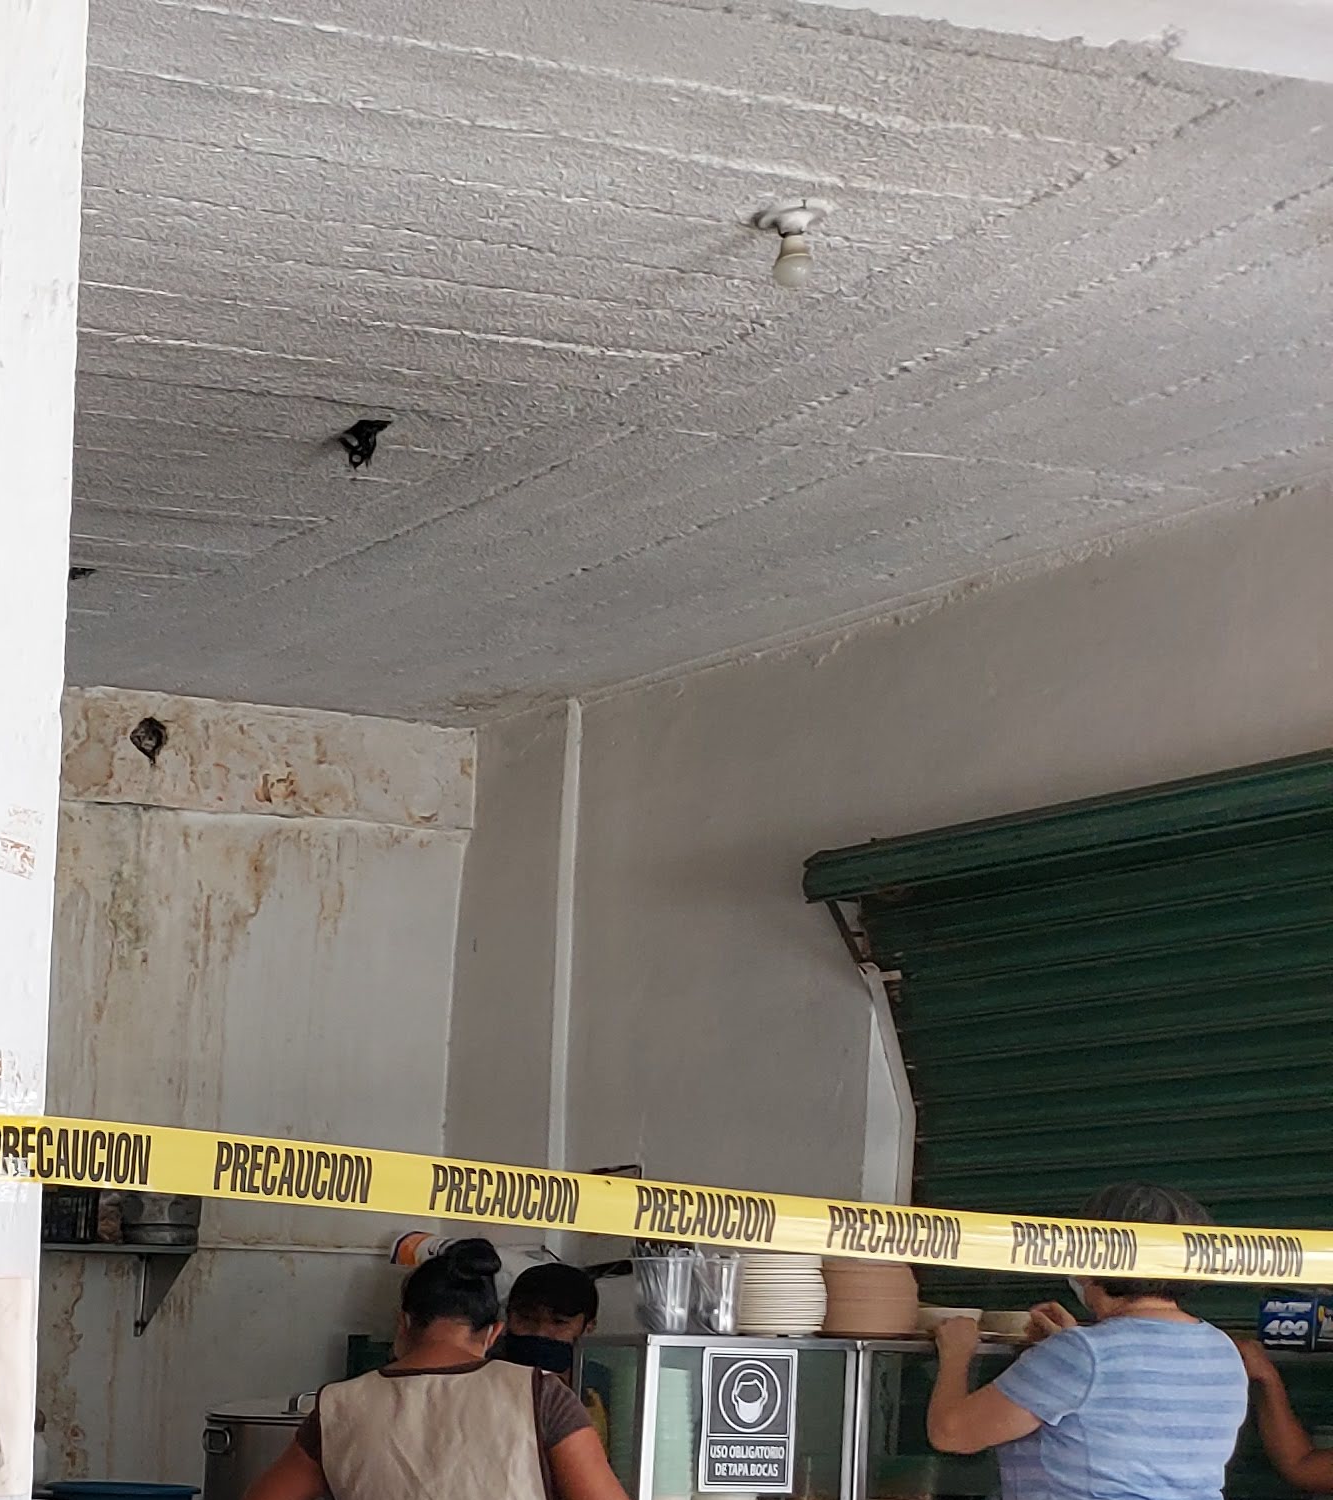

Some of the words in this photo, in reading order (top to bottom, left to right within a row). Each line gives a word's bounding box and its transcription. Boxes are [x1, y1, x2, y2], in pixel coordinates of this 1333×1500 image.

[213, 1139, 373, 1205] PRECAUCION
[428, 1161, 581, 1225] PRECAUCION
[634, 1183, 777, 1244] PRECAUCION
[826, 1204, 962, 1260] PRECAUCION
[1010, 1220, 1138, 1272] PRECAUCION
[1181, 1230, 1305, 1278] PRECAUCION
[1263, 1319, 1309, 1336] 400
[709, 1444, 729, 1459] USO
[729, 1445, 785, 1460] OBLIGATORIO
[714, 1462, 727, 1476] DE
